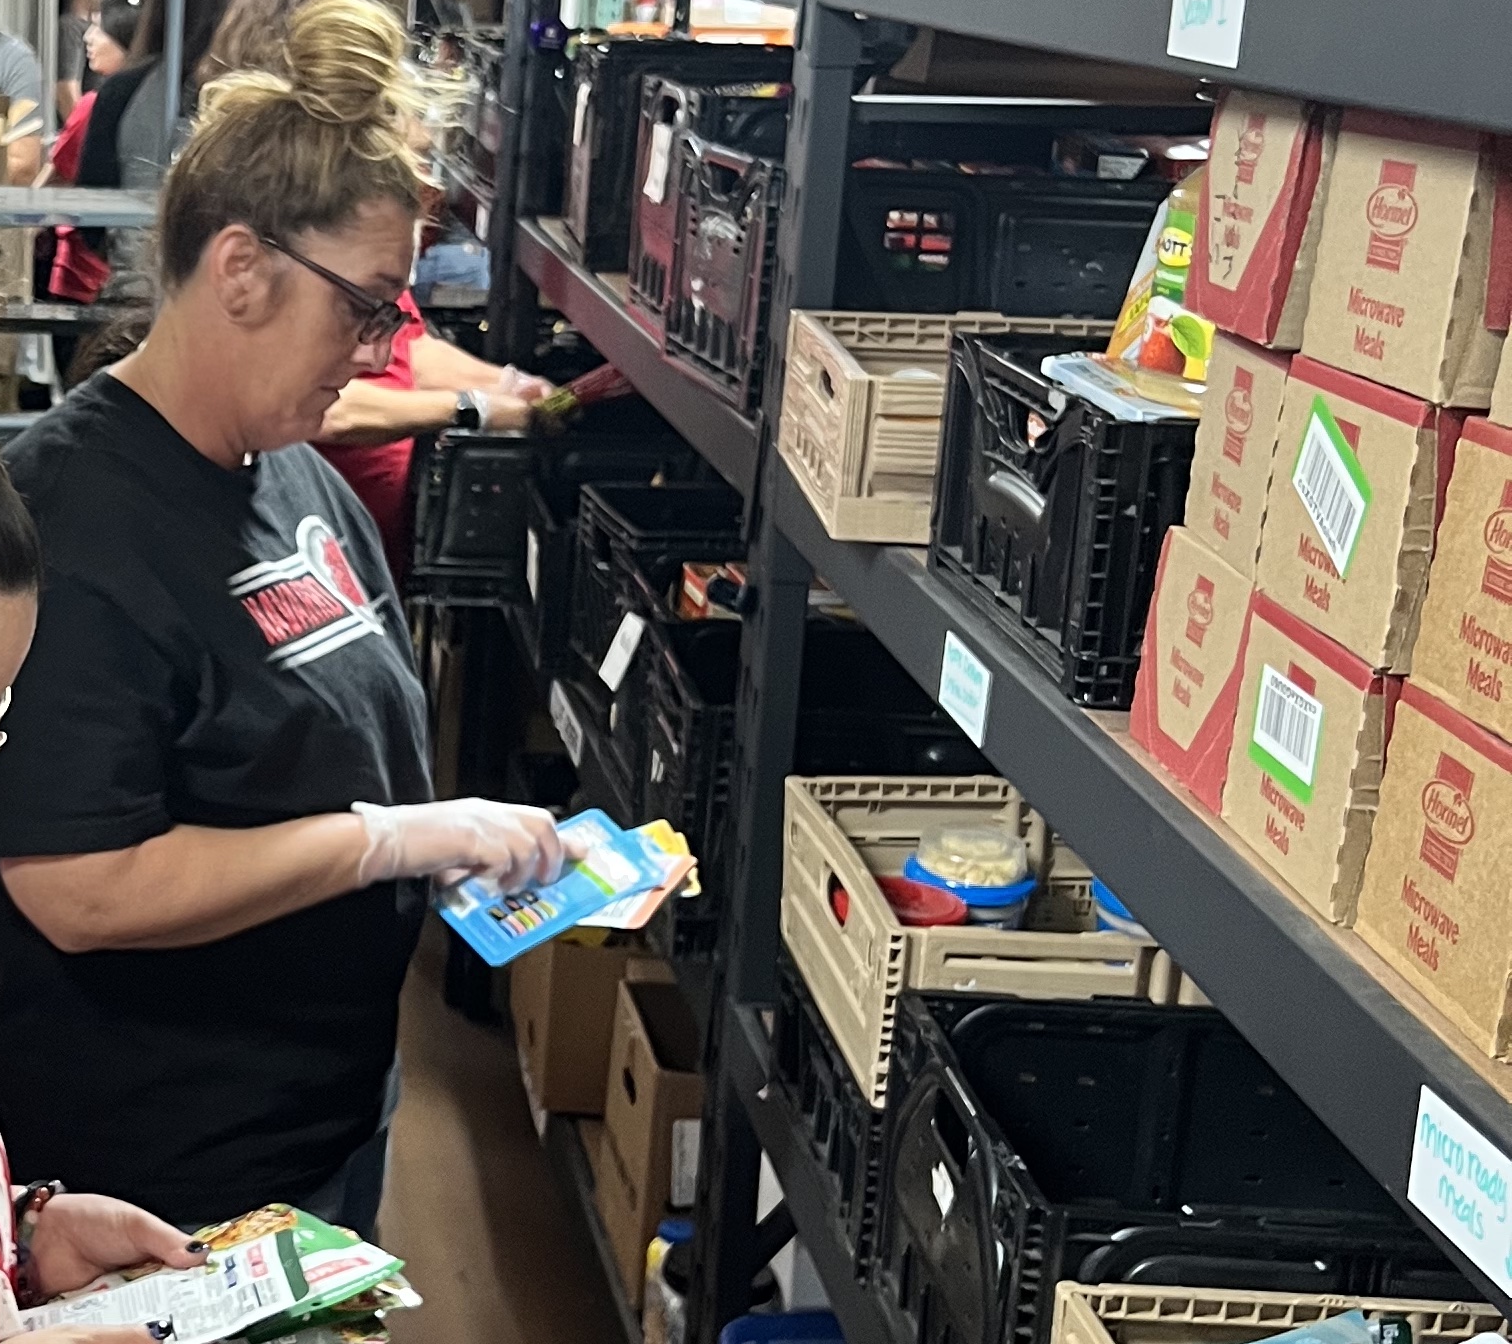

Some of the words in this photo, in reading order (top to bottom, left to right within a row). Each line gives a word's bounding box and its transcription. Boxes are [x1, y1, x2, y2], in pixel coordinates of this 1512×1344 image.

[1347, 285, 1406, 329] Microwave
[1353, 324, 1386, 362] Meals
[1303, 573, 1332, 613] Meals
[1465, 656, 1504, 703] Meals
[1259, 770, 1306, 832] Microwave
[1425, 786, 1471, 836] Hormel
[1264, 813, 1290, 857] Meals
[1400, 873, 1461, 946] Microwave
[1406, 920, 1440, 972] Meals
